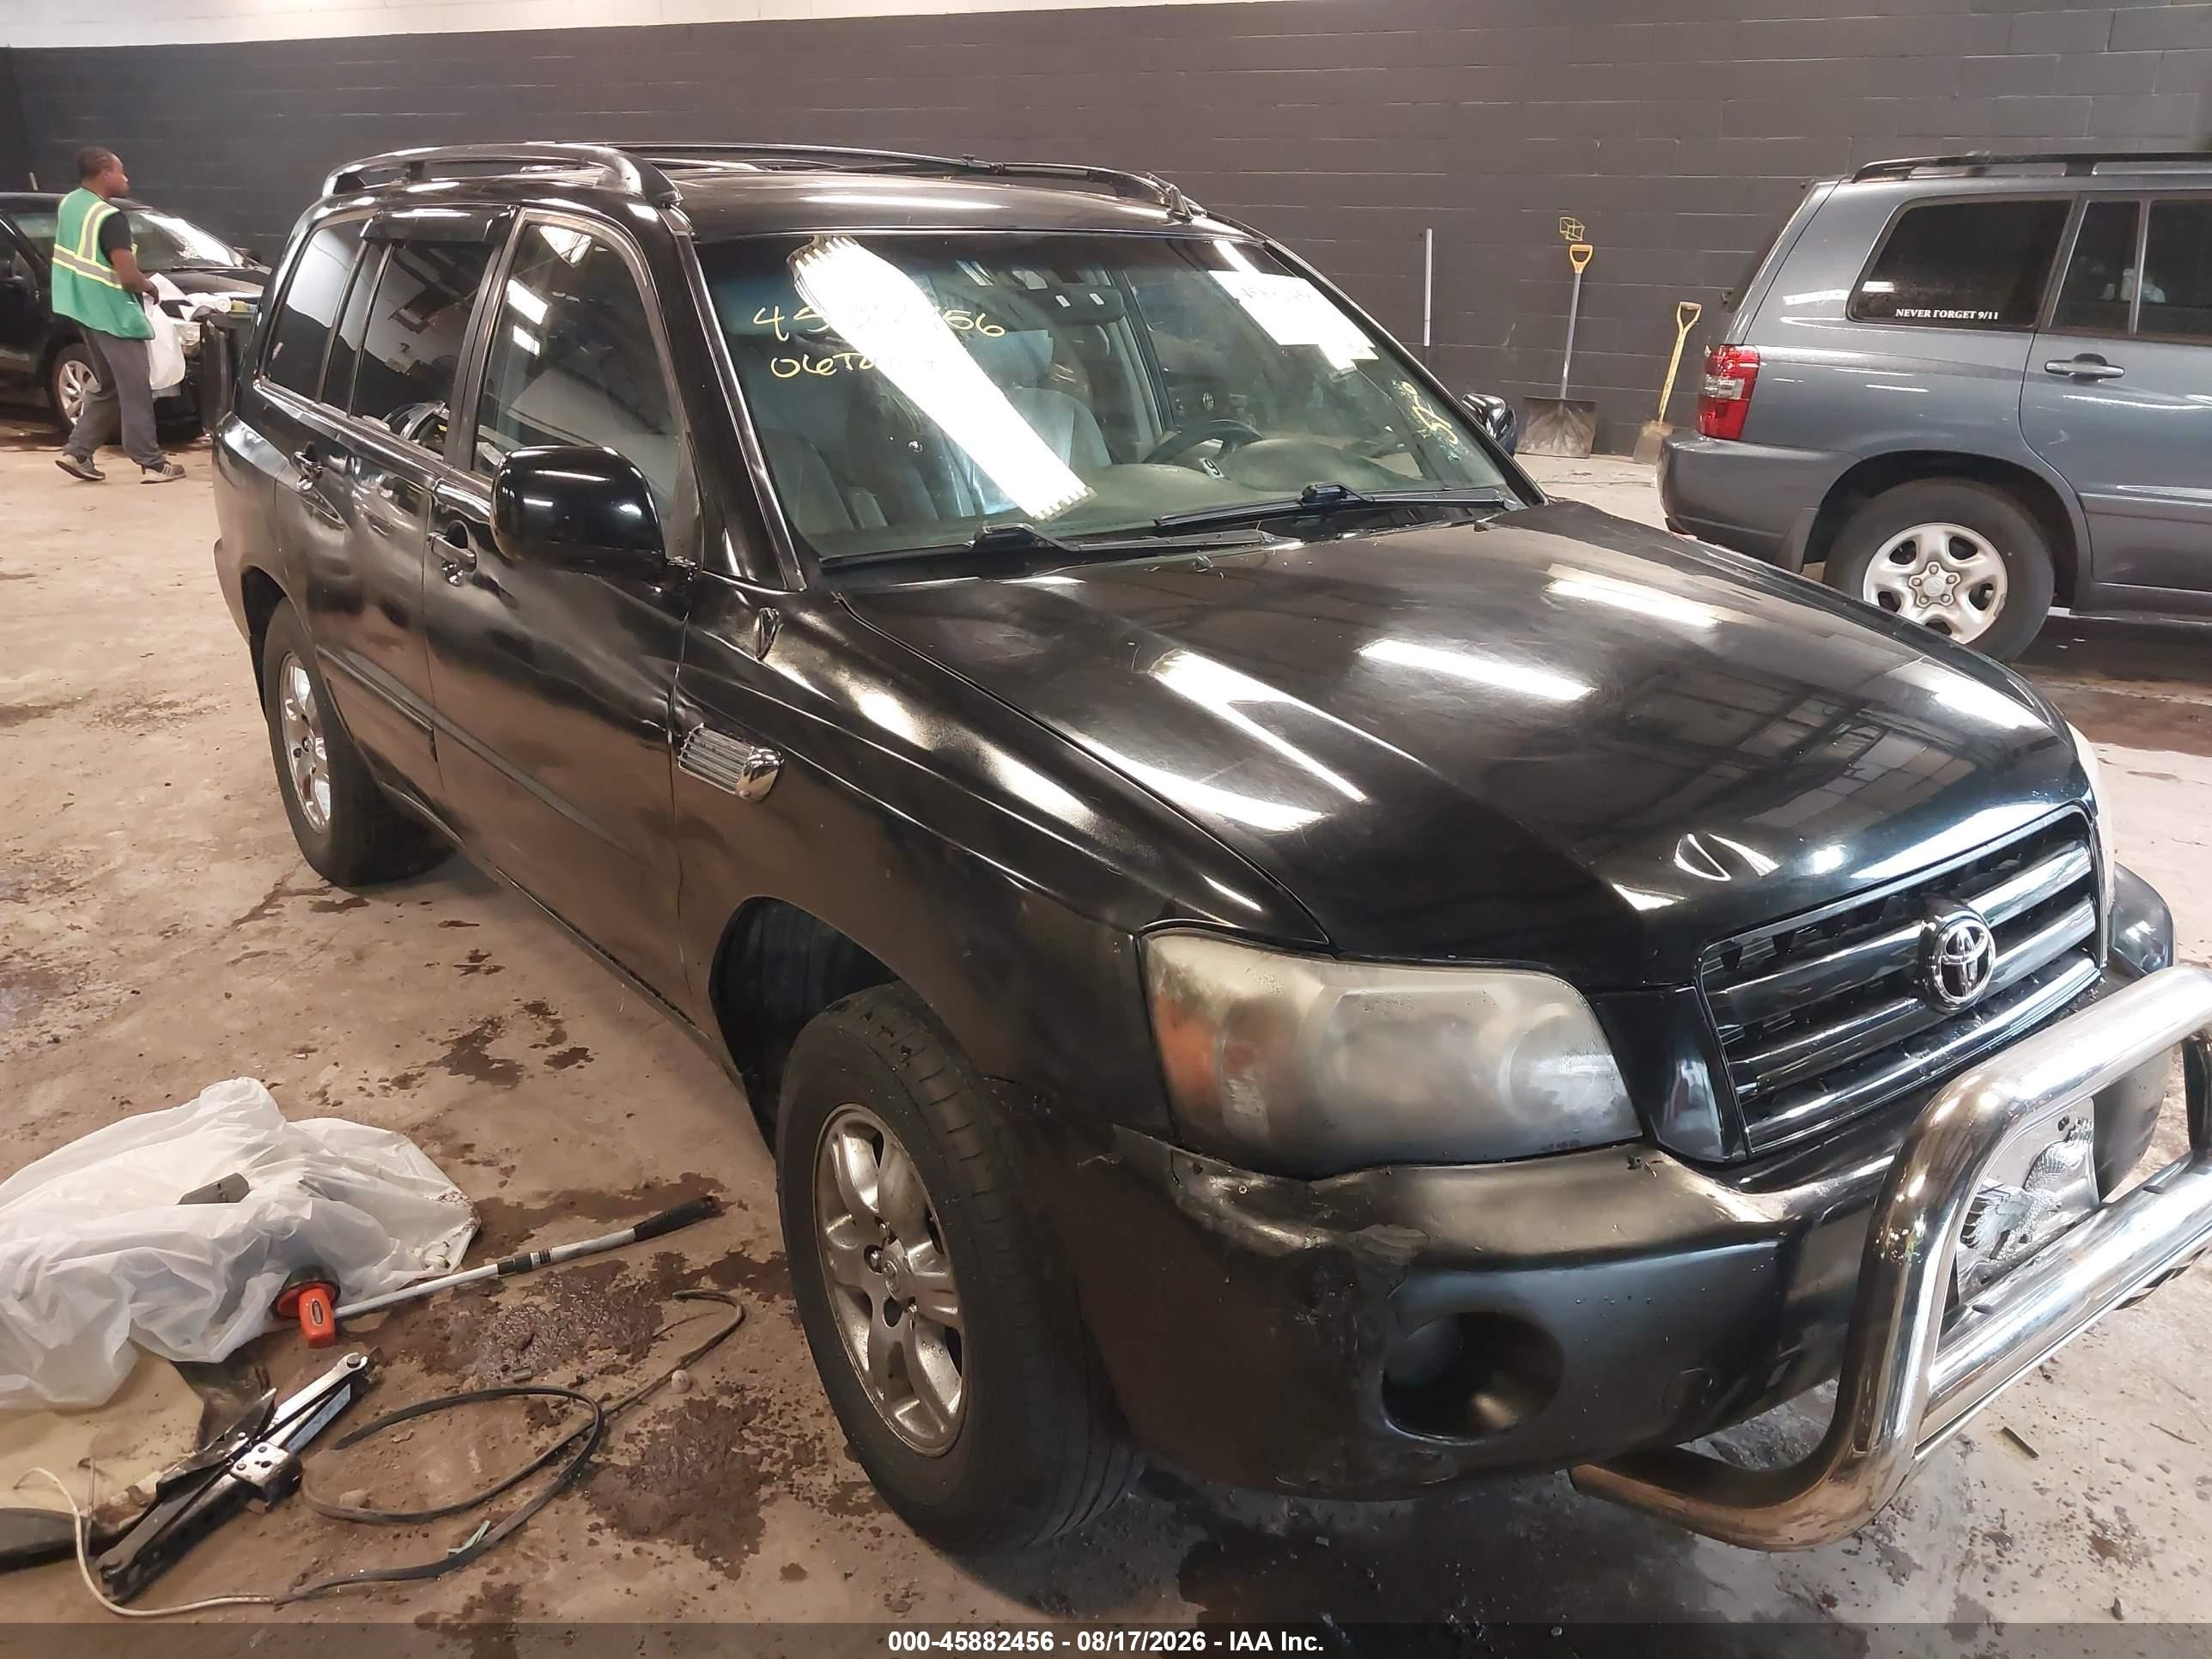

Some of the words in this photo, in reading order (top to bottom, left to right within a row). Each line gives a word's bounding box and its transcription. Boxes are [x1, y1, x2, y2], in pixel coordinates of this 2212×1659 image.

[1895, 308, 1931, 318] NEVER
[1932, 309, 1977, 319] FORGET
[1978, 310, 1999, 320] 9/11
